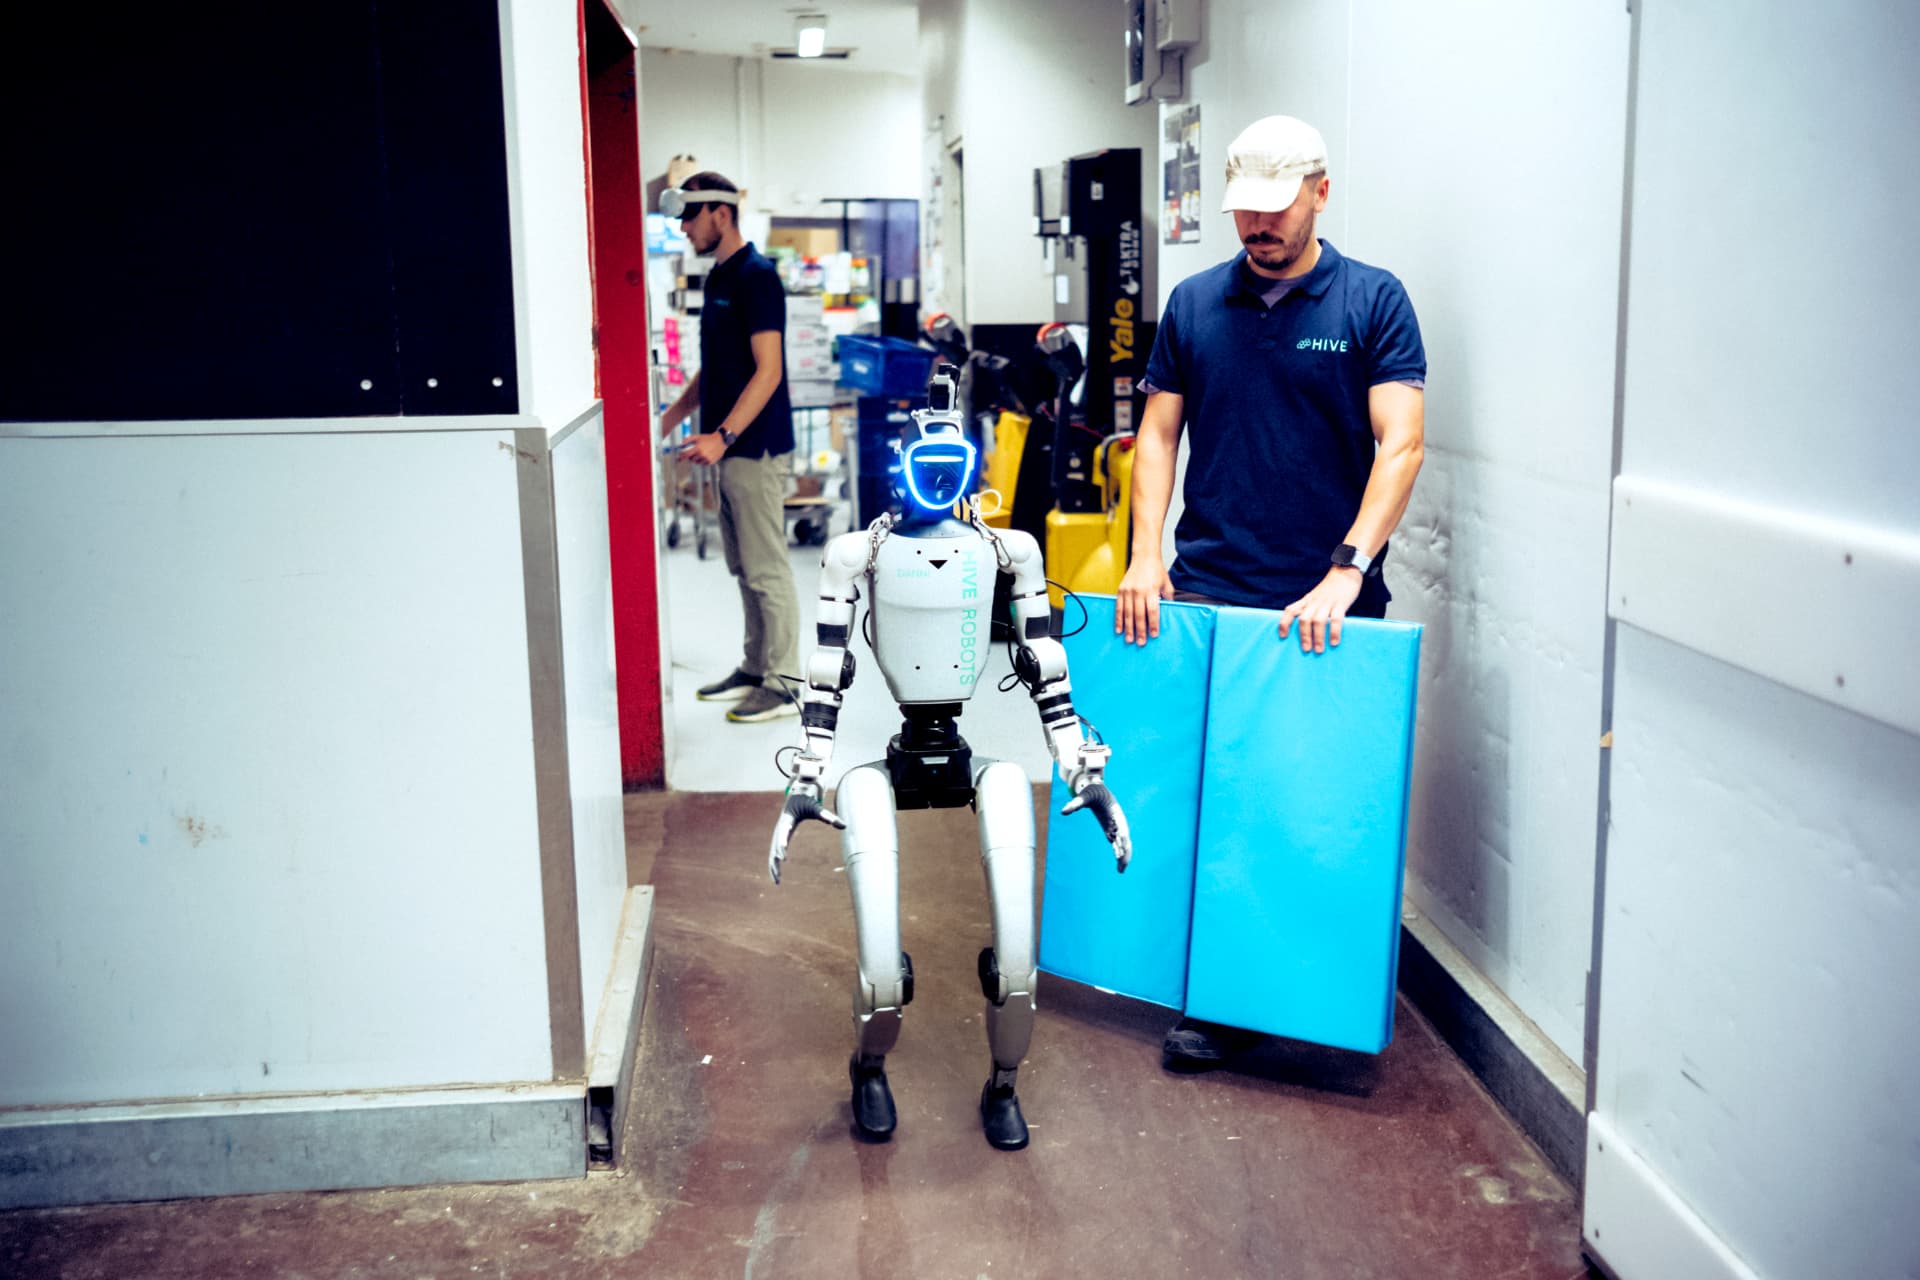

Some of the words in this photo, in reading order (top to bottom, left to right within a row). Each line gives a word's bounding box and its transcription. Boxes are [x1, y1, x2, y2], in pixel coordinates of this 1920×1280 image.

[1109, 297, 1134, 363] Yale
[1312, 338, 1348, 352] HIVE
[961, 550, 977, 600] HIVE
[960, 608, 977, 686] ROBOTS
